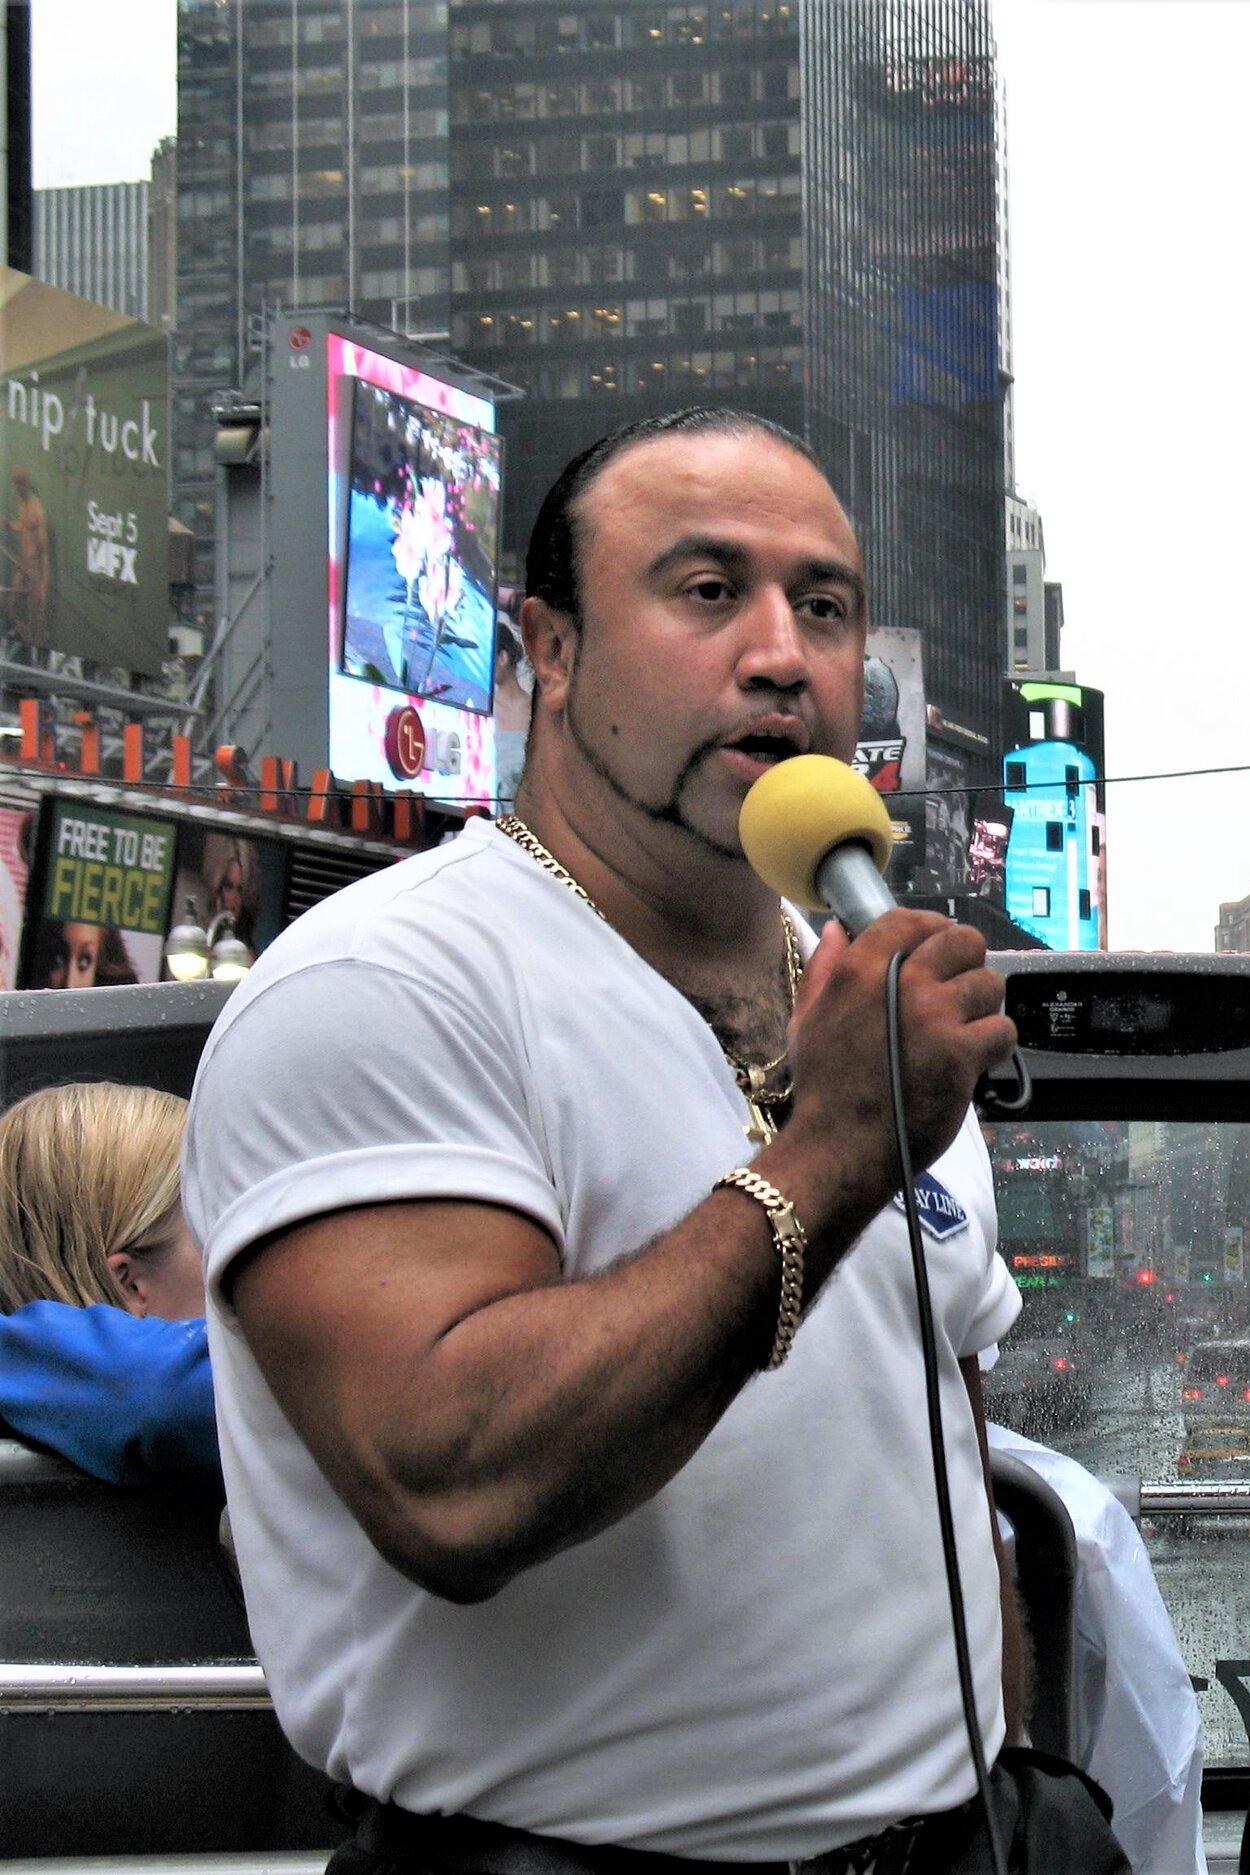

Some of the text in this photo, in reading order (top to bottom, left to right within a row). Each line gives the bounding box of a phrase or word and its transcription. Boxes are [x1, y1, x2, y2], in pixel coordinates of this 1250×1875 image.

[290, 356, 310, 369] LG
[8, 370, 160, 467] nip tuck
[88, 500, 139, 543] Sept 5
[424, 726, 462, 775] LG
[58, 817, 167, 872] FREE TO BE
[51, 856, 164, 932] FIERCE
